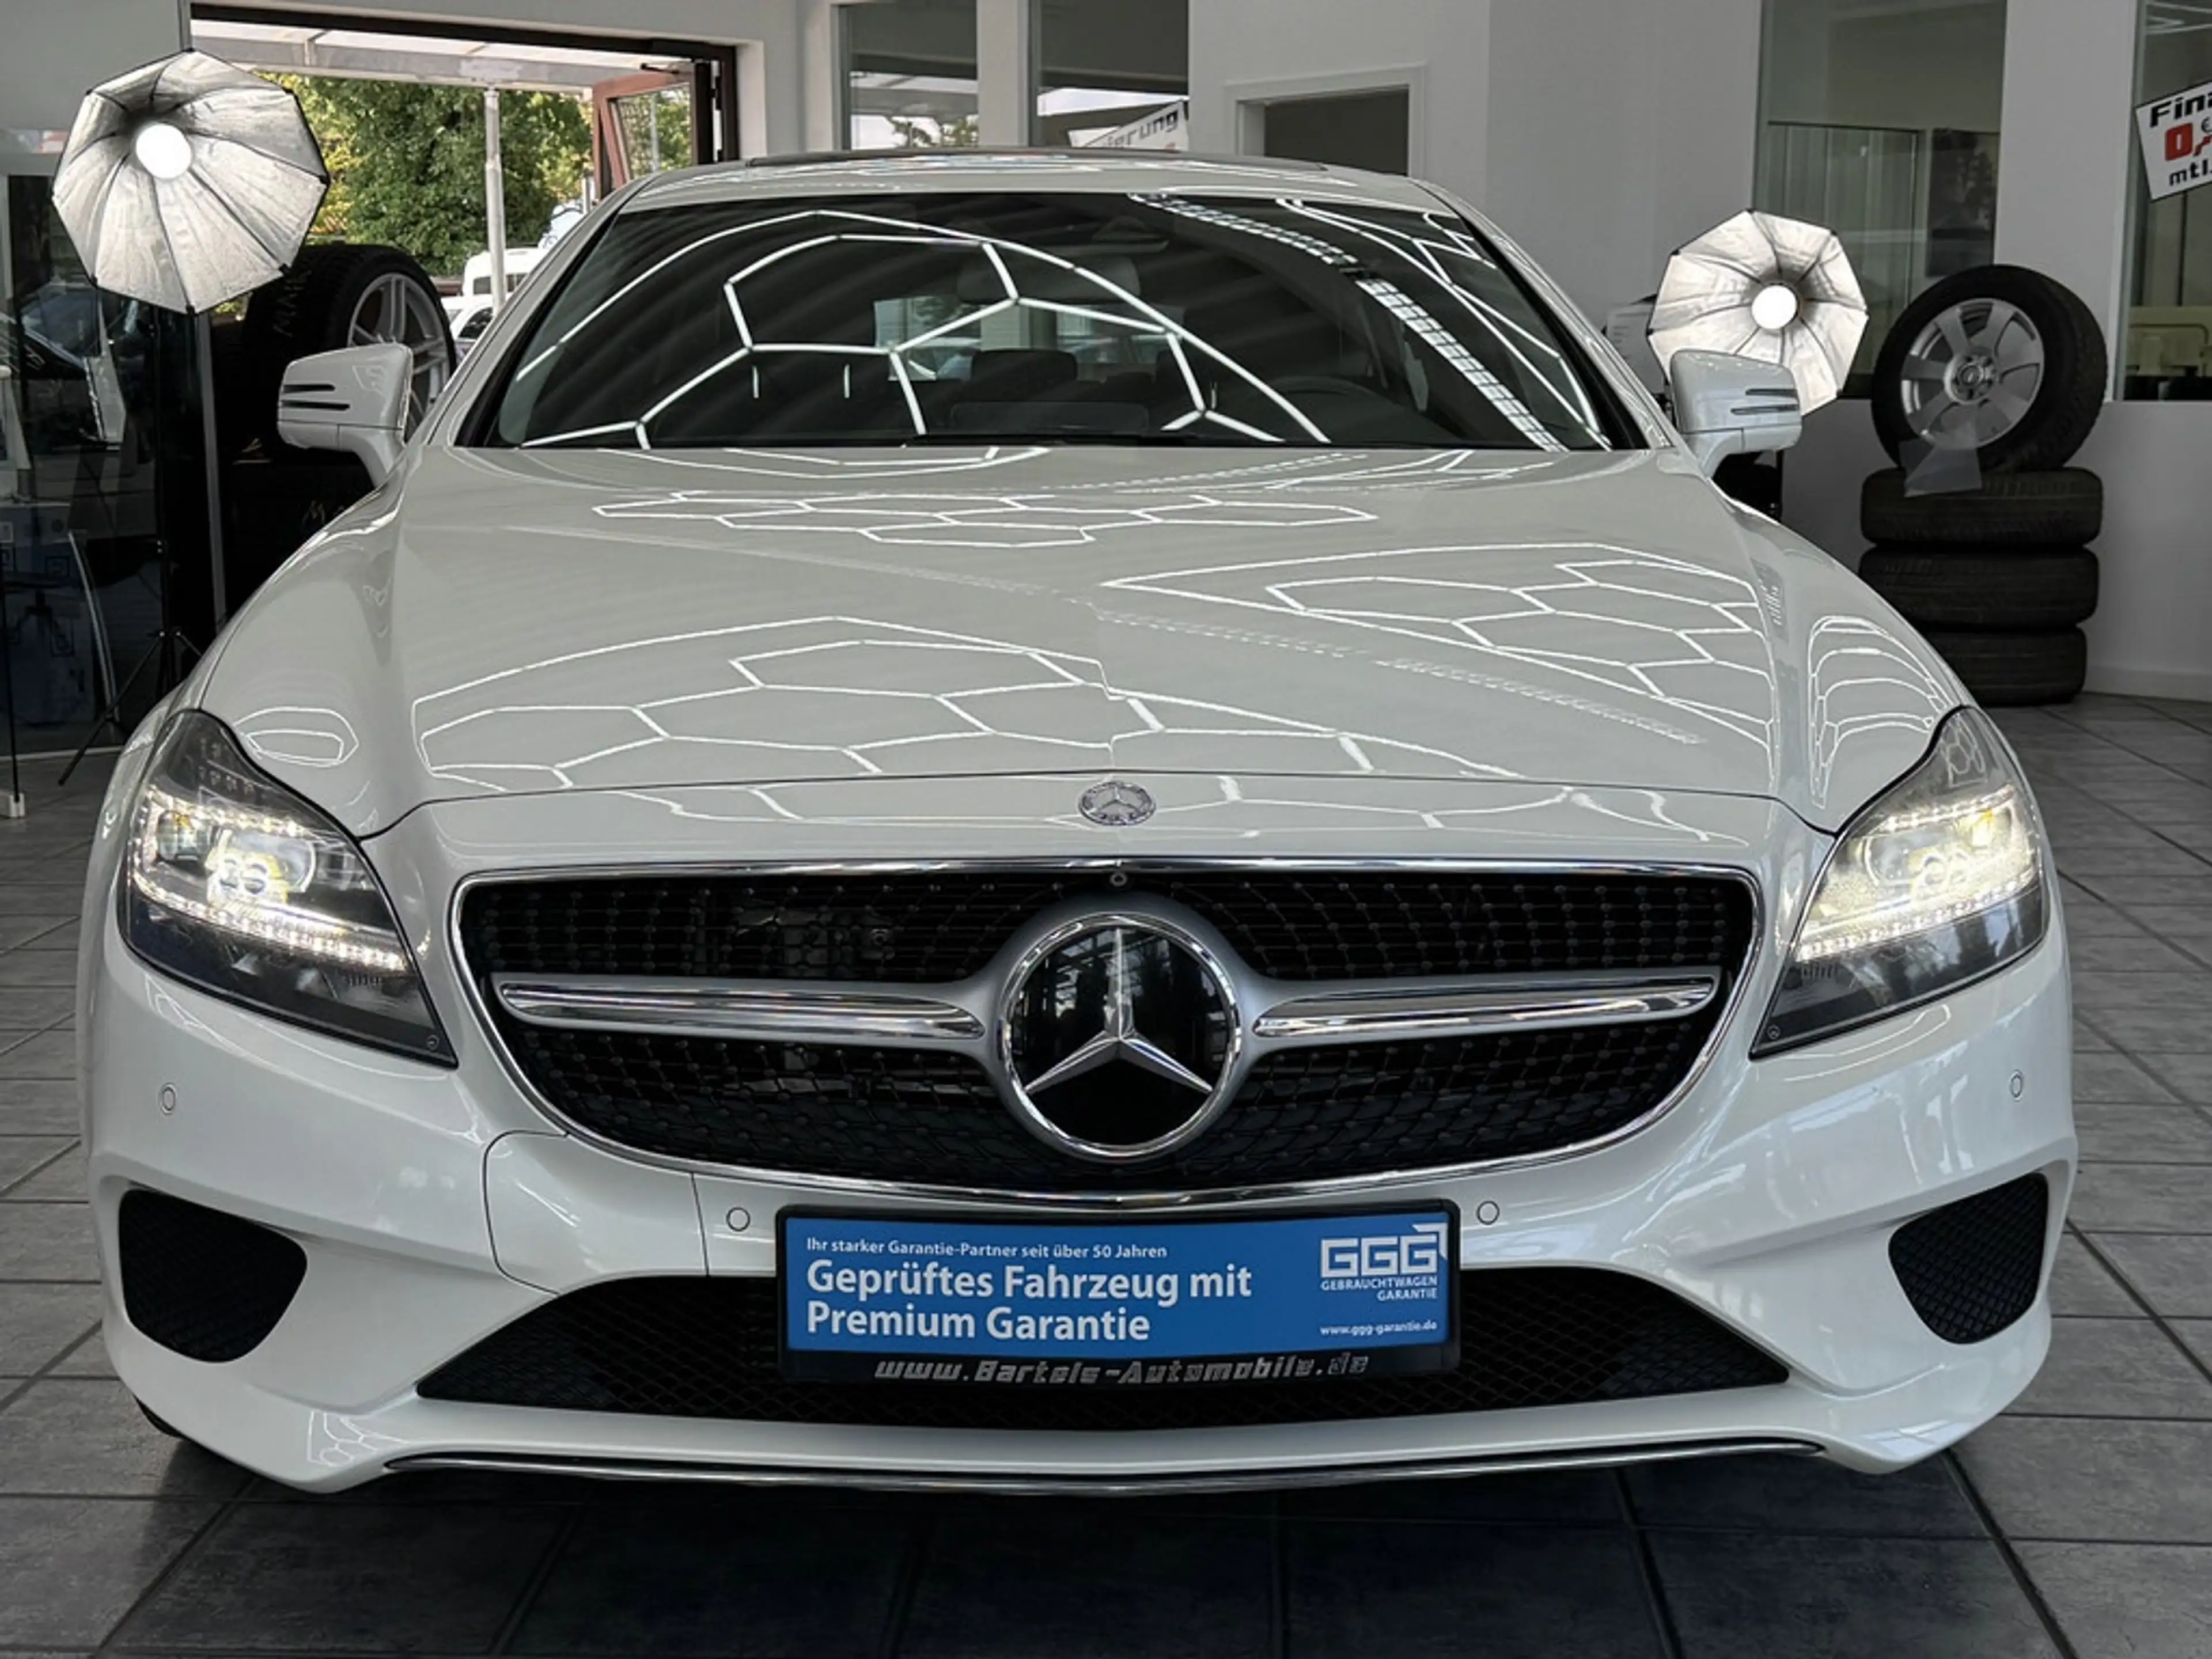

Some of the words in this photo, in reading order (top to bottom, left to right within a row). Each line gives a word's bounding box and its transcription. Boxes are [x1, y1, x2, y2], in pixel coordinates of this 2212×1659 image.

[2150, 92, 2212, 128] Fin
[2165, 123, 2193, 161] 0
[807, 1237, 828, 1252] Ihr
[831, 1238, 884, 1254] starker
[888, 1240, 1018, 1257] Garantie-Partner
[1021, 1243, 1048, 1258] seit
[1053, 1244, 1090, 1259] über
[1092, 1245, 1112, 1259] 50
[1114, 1245, 1167, 1259] Jahren
[1321, 1234, 1438, 1278] GGG
[807, 1259, 994, 1302] Geprüftes
[1005, 1264, 1179, 1308] Fahrzeug
[1190, 1263, 1252, 1297] mit
[1320, 1275, 1438, 1291] GEBRAUCHTWAGEN
[1377, 1288, 1437, 1301] GARANTIE
[808, 1301, 975, 1338] Premium
[986, 1306, 1150, 1340] Garantie
[1320, 1320, 1438, 1336] www.ggg-garantie.de
[874, 1352, 1369, 1383] www.Bartels-Automobile.de
